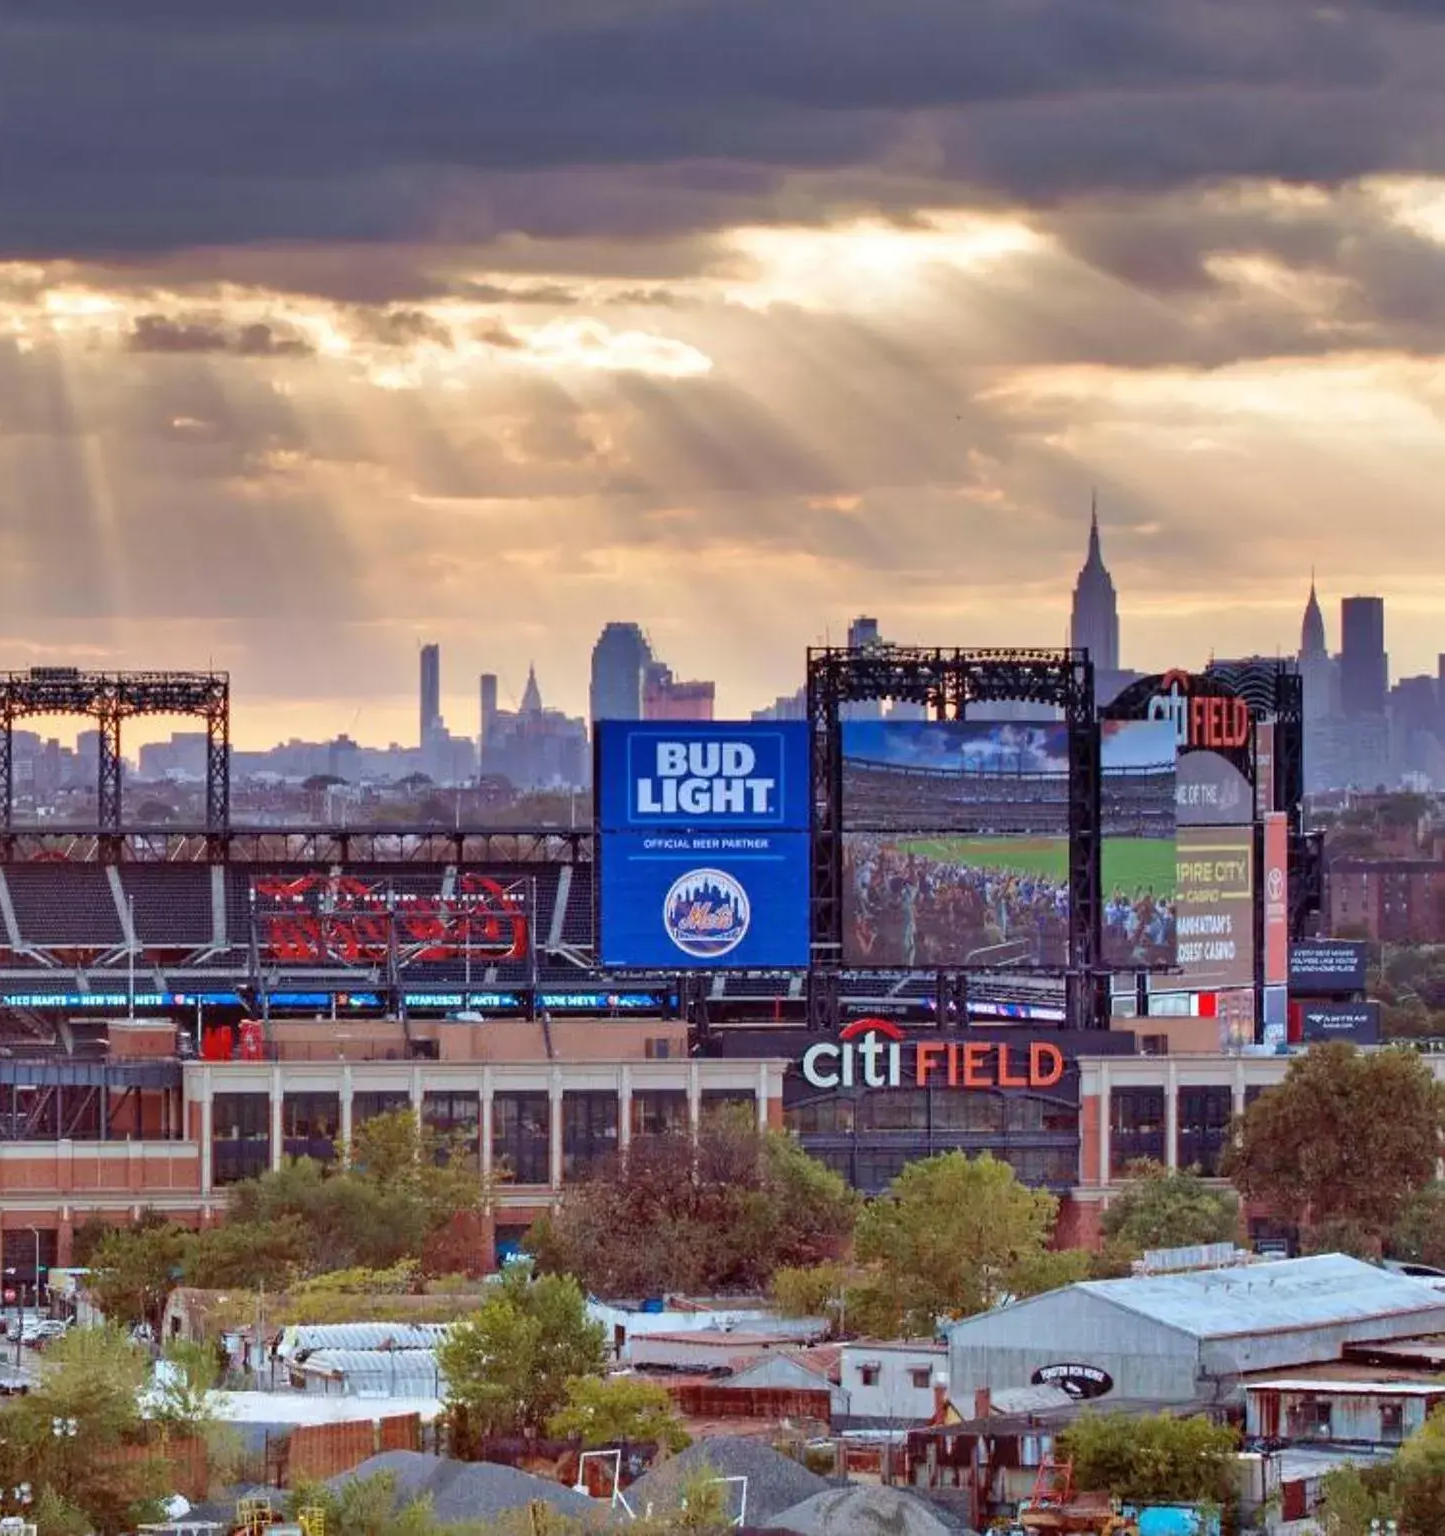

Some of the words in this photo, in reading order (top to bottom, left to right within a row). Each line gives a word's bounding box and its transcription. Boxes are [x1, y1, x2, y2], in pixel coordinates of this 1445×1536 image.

[1191, 696, 1248, 746] FIELD
[656, 741, 756, 778] BUD
[643, 838, 691, 849] OFFICIAL
[693, 838, 720, 849] BEER
[722, 838, 768, 849] PARTNER
[1215, 860, 1246, 883] CITY
[804, 1030, 901, 1088] citi
[916, 1041, 1065, 1087] FIELD
